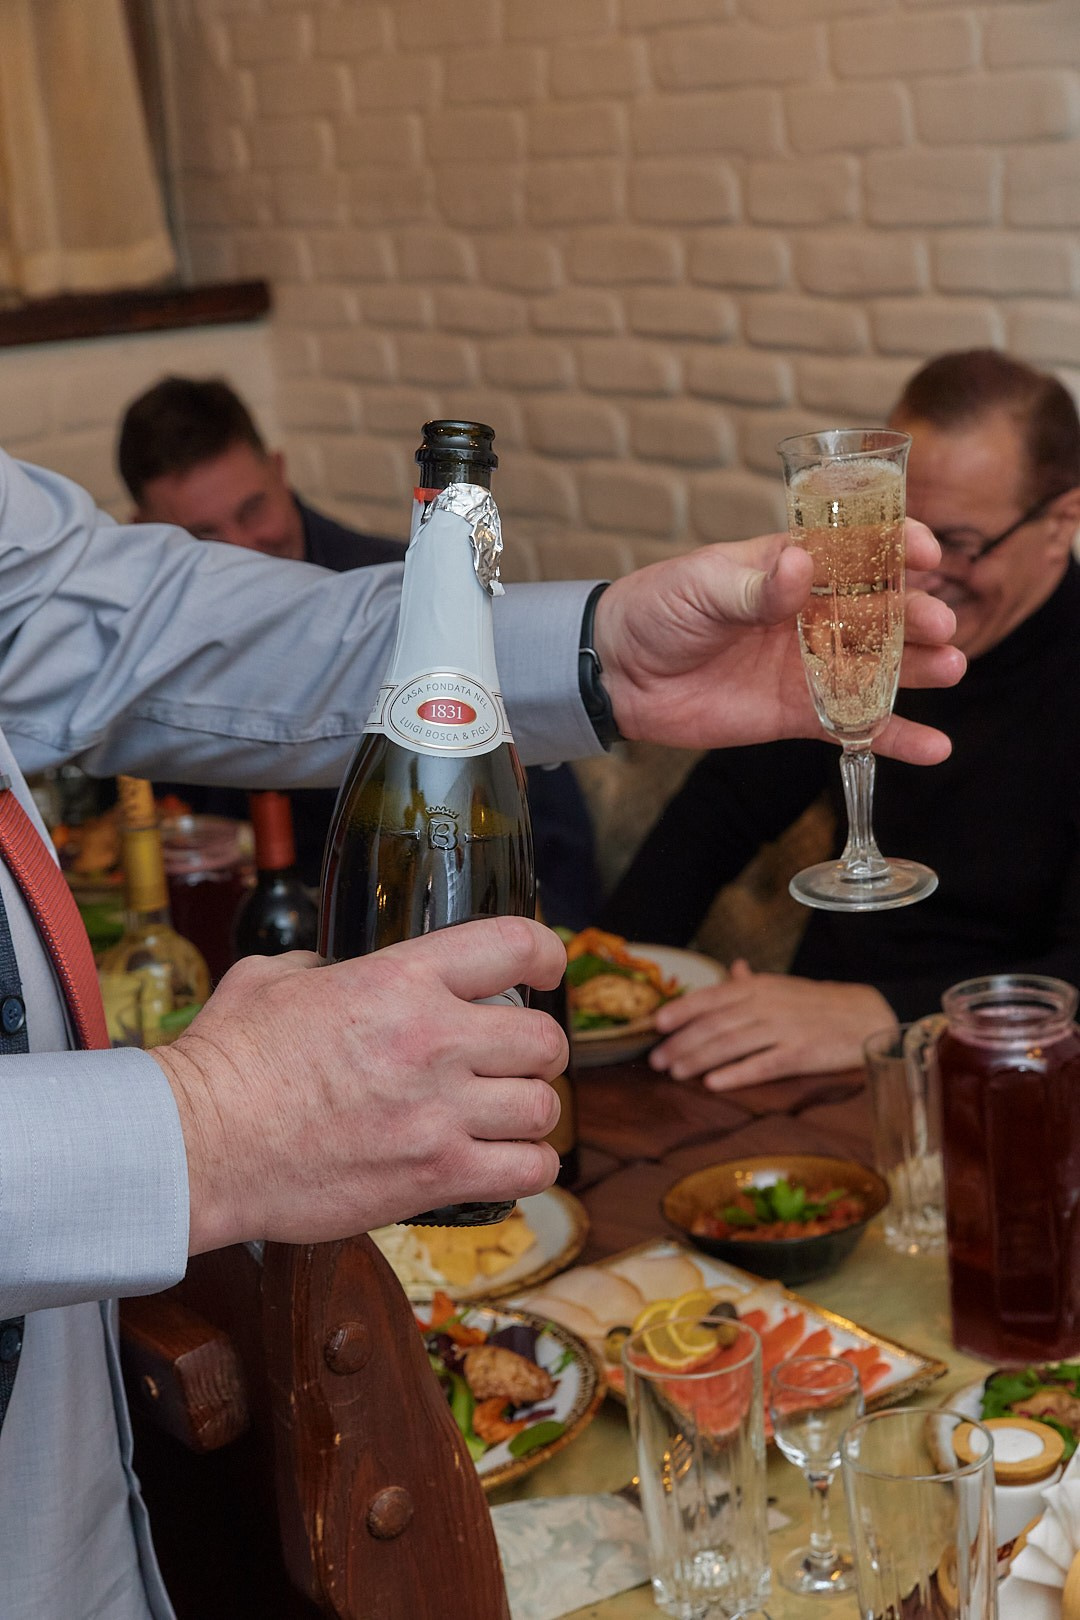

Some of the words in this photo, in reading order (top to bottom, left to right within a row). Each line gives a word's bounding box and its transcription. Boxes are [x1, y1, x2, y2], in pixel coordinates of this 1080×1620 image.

[401, 687, 424, 705] CASA
[426, 683, 471, 696] FONDATA
[473, 692, 488, 709] NEL
[431, 704, 462, 720] 1831
[400, 716, 423, 734] LUIGI
[425, 729, 459, 741] BOSCA
[462, 732, 469, 740] &
[471, 723, 491, 738] FIGLI
